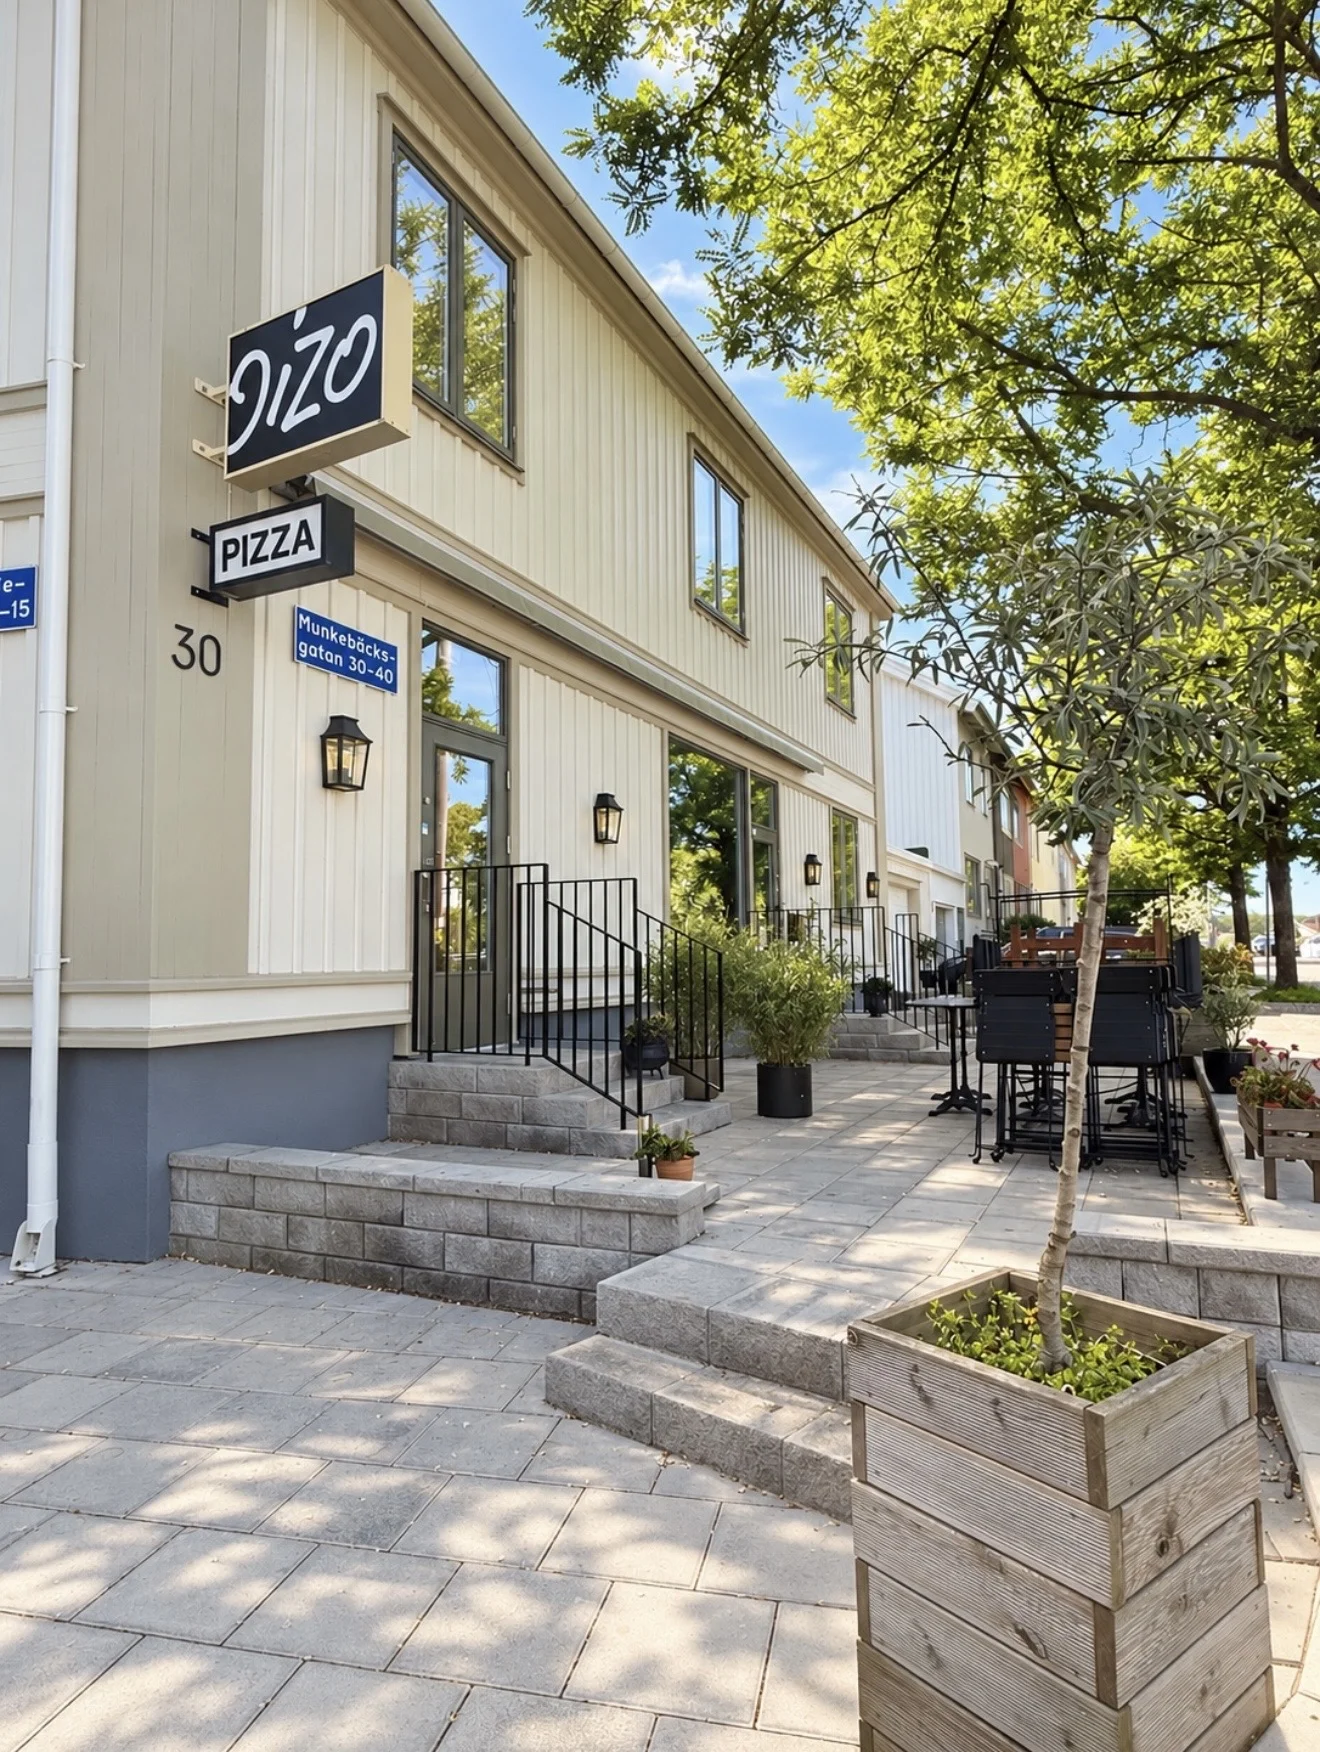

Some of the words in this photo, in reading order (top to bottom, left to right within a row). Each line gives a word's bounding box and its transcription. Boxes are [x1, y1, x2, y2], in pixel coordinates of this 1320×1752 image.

[222, 518, 316, 573] PIZZA
[0, 576, 25, 593] e-
[171, 623, 222, 677] 30
[298, 613, 395, 663] Munkebäcks-
[298, 641, 343, 667] gatan
[348, 655, 394, 684] 30-40
